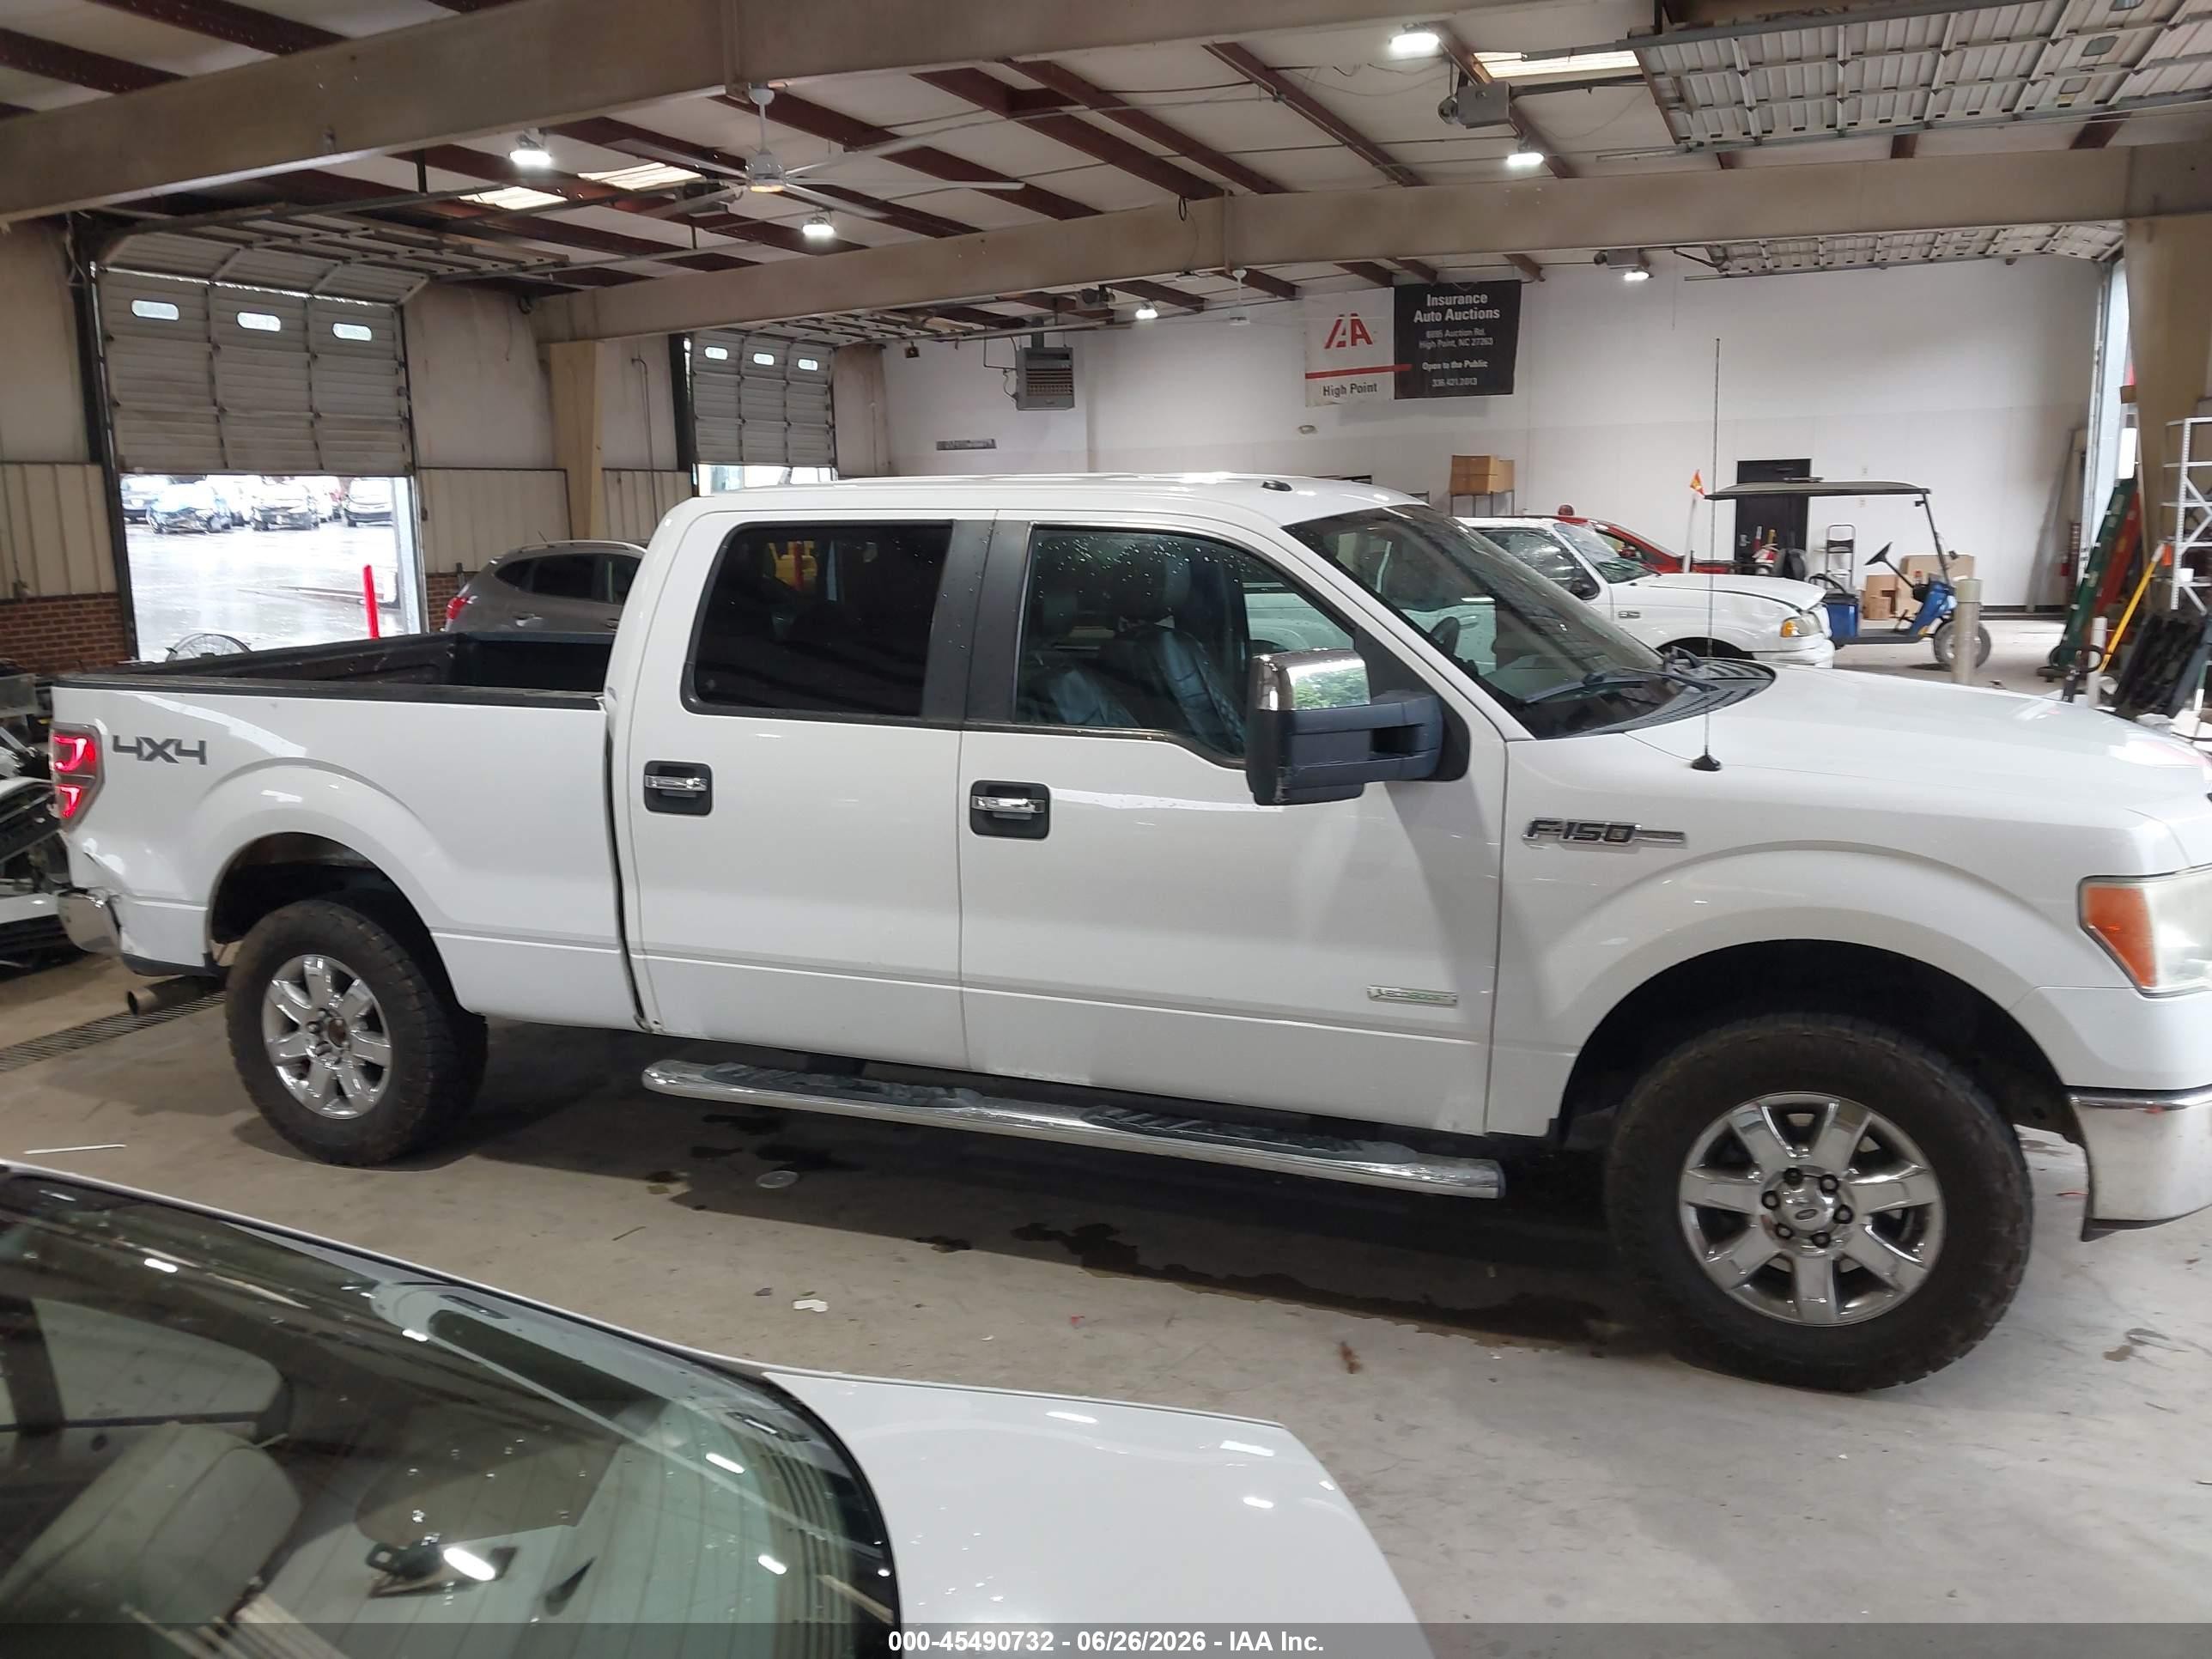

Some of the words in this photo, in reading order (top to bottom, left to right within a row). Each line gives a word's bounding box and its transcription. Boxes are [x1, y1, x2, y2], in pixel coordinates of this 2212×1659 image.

[1426, 293, 1488, 307] Insurance
[1413, 310, 1443, 323] Auto
[1444, 307, 1501, 321] Auctions
[1444, 329, 1474, 337] Auction
[1419, 340, 1437, 349] High
[1458, 337, 1471, 346] NC
[1422, 362, 1442, 372] Open
[1450, 360, 1462, 368] the
[1463, 359, 1489, 368] Public
[1322, 384, 1347, 398] High
[1350, 381, 1377, 394] Point
